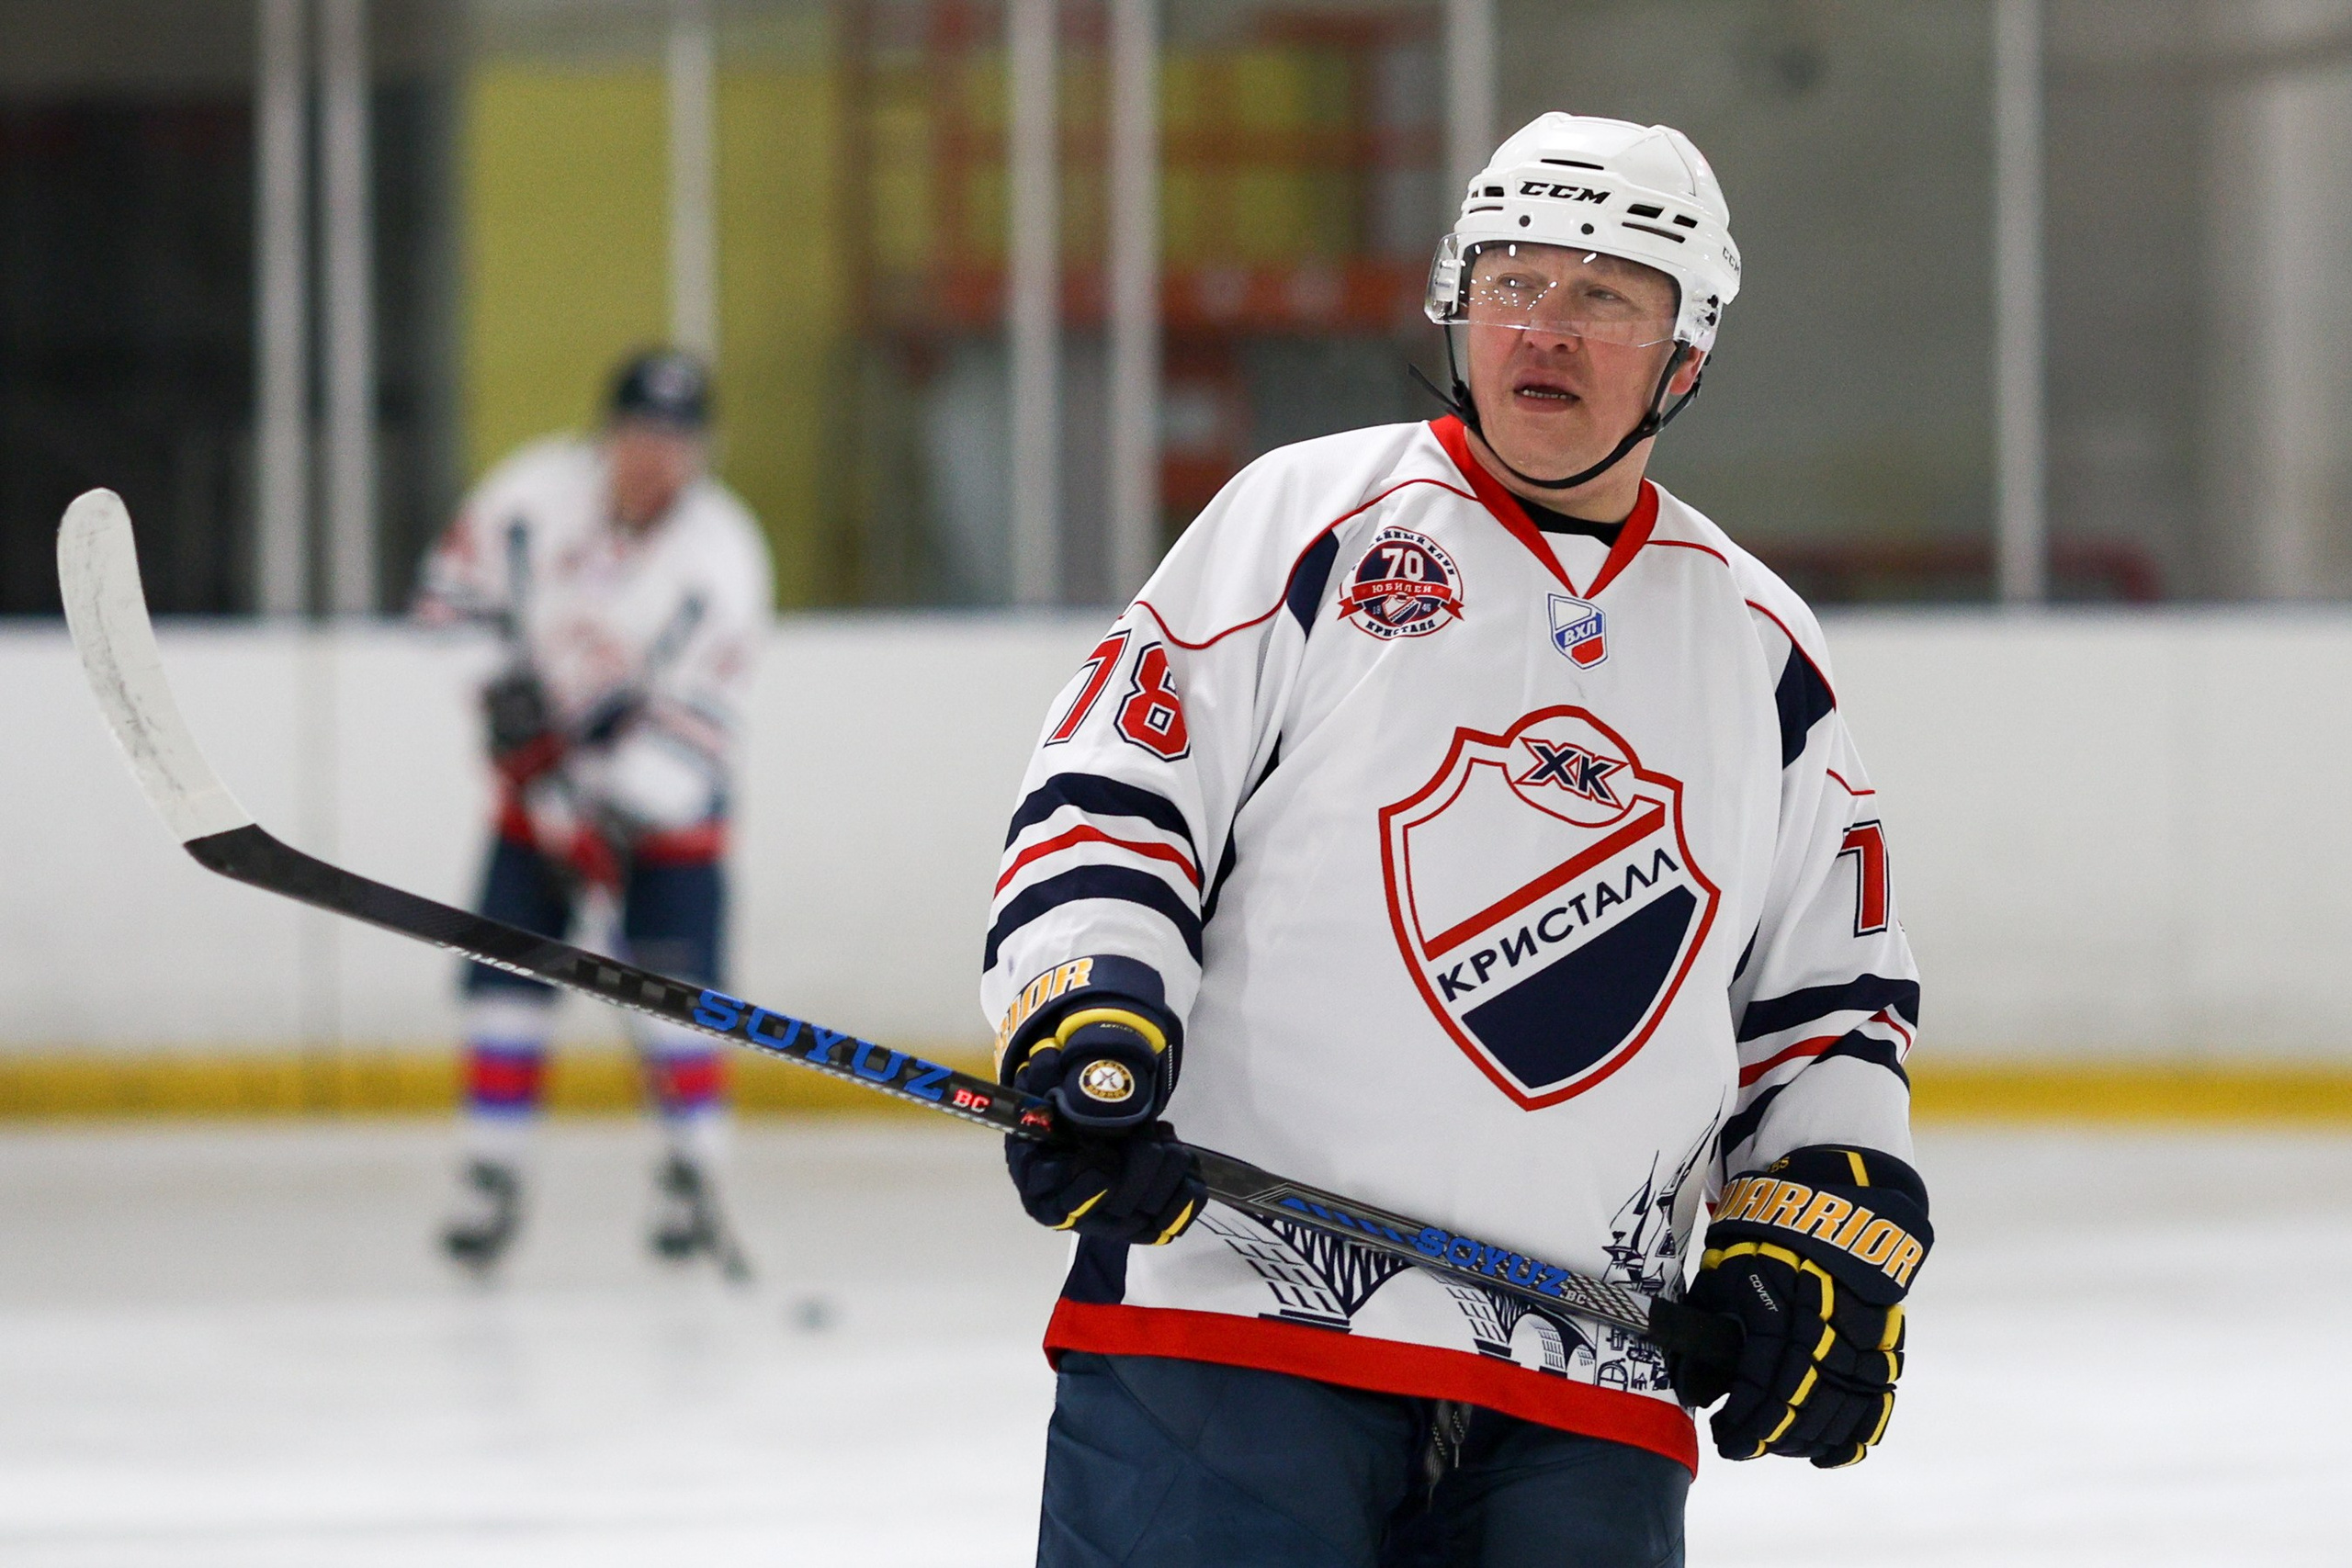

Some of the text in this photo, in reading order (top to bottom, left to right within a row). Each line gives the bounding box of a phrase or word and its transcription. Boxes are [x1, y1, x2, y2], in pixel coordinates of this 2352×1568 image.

[1519, 181, 1612, 205] CCM
[1381, 547, 1424, 581] 70
[1365, 619, 1436, 637] КРИСТАЛЛ
[1564, 619, 1598, 646] ВХЛ
[1042, 628, 1191, 763] 78
[1525, 740, 1620, 804] ХК
[1836, 818, 1892, 939] 7
[1435, 847, 1679, 1003] КРИСТАЛЛ
[693, 988, 990, 1114] SOYUZ BC
[1415, 1225, 1570, 1297] SOYUZ
[1748, 1273, 1781, 1314] COVERT
